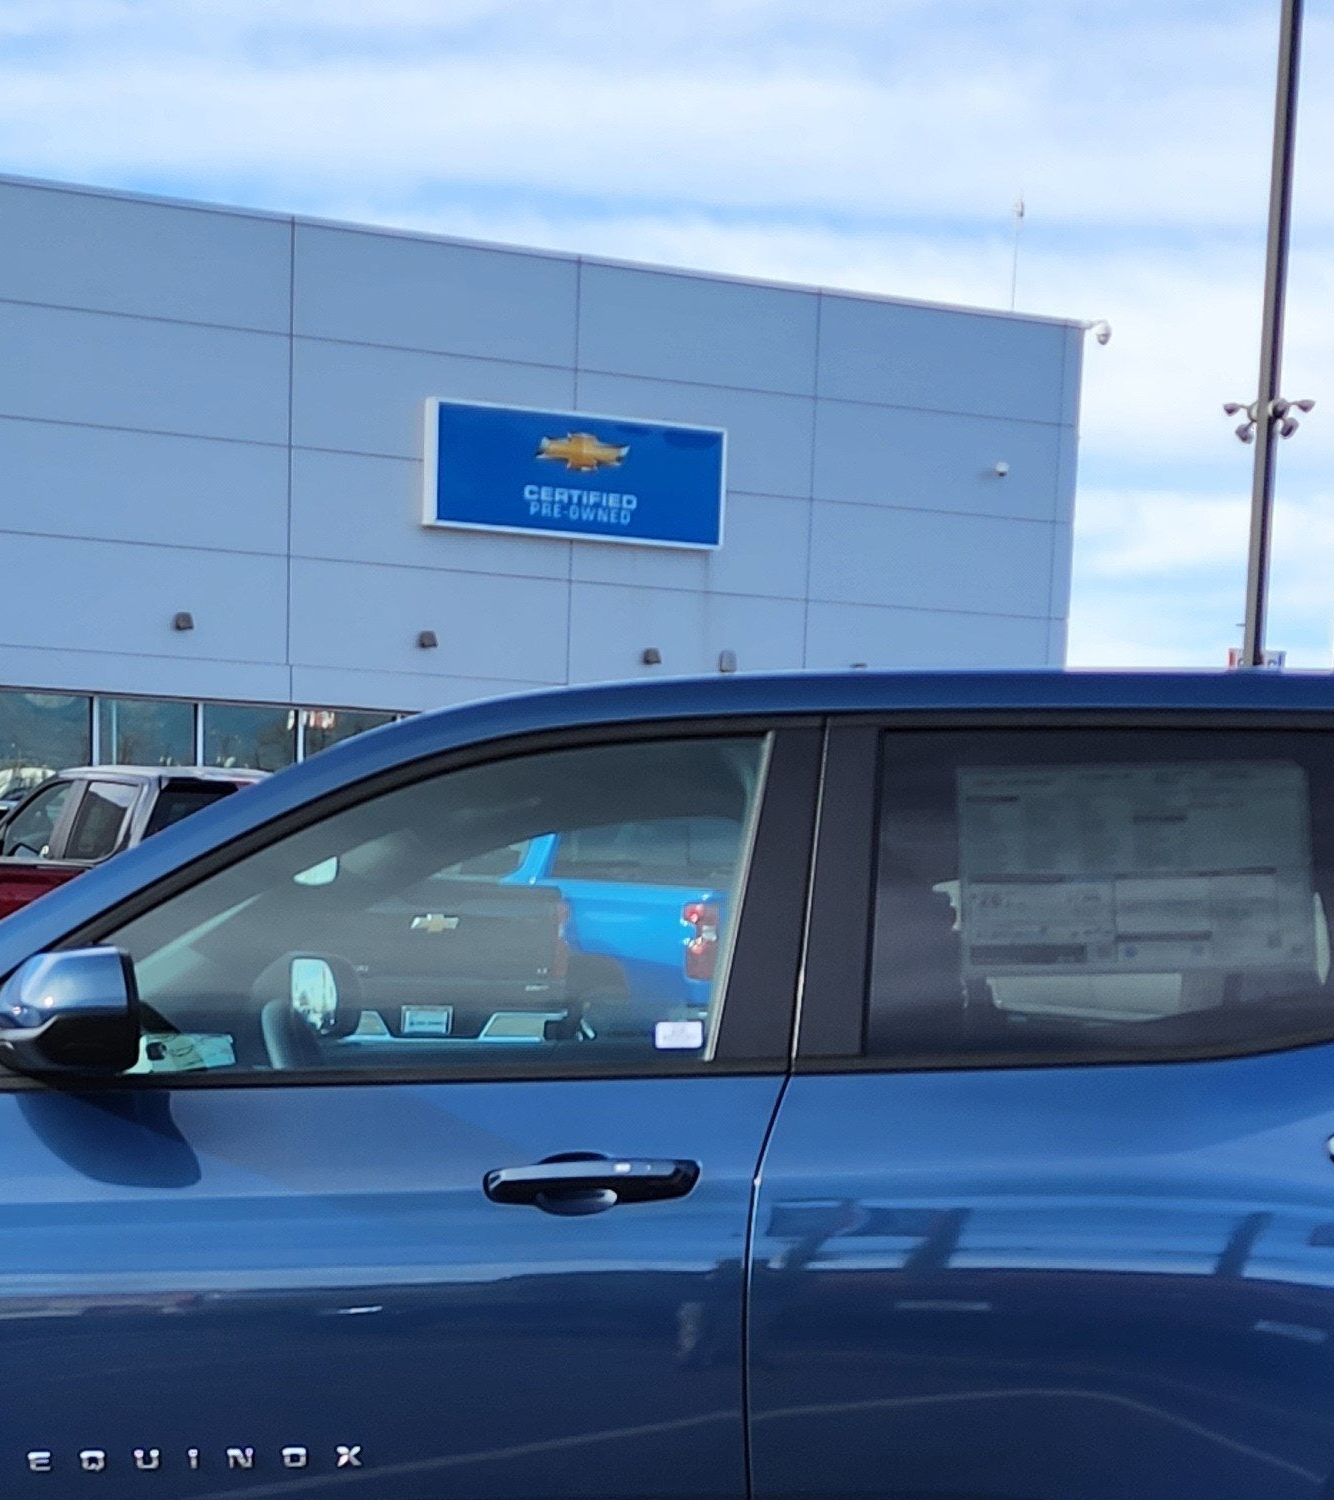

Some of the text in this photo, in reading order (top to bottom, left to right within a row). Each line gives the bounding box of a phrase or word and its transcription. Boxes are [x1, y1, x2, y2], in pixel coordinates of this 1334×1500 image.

[524, 485, 637, 510] CERTIFIED
[529, 502, 631, 525] PRE-OWNED
[27, 1446, 363, 1472] EQUINOX
